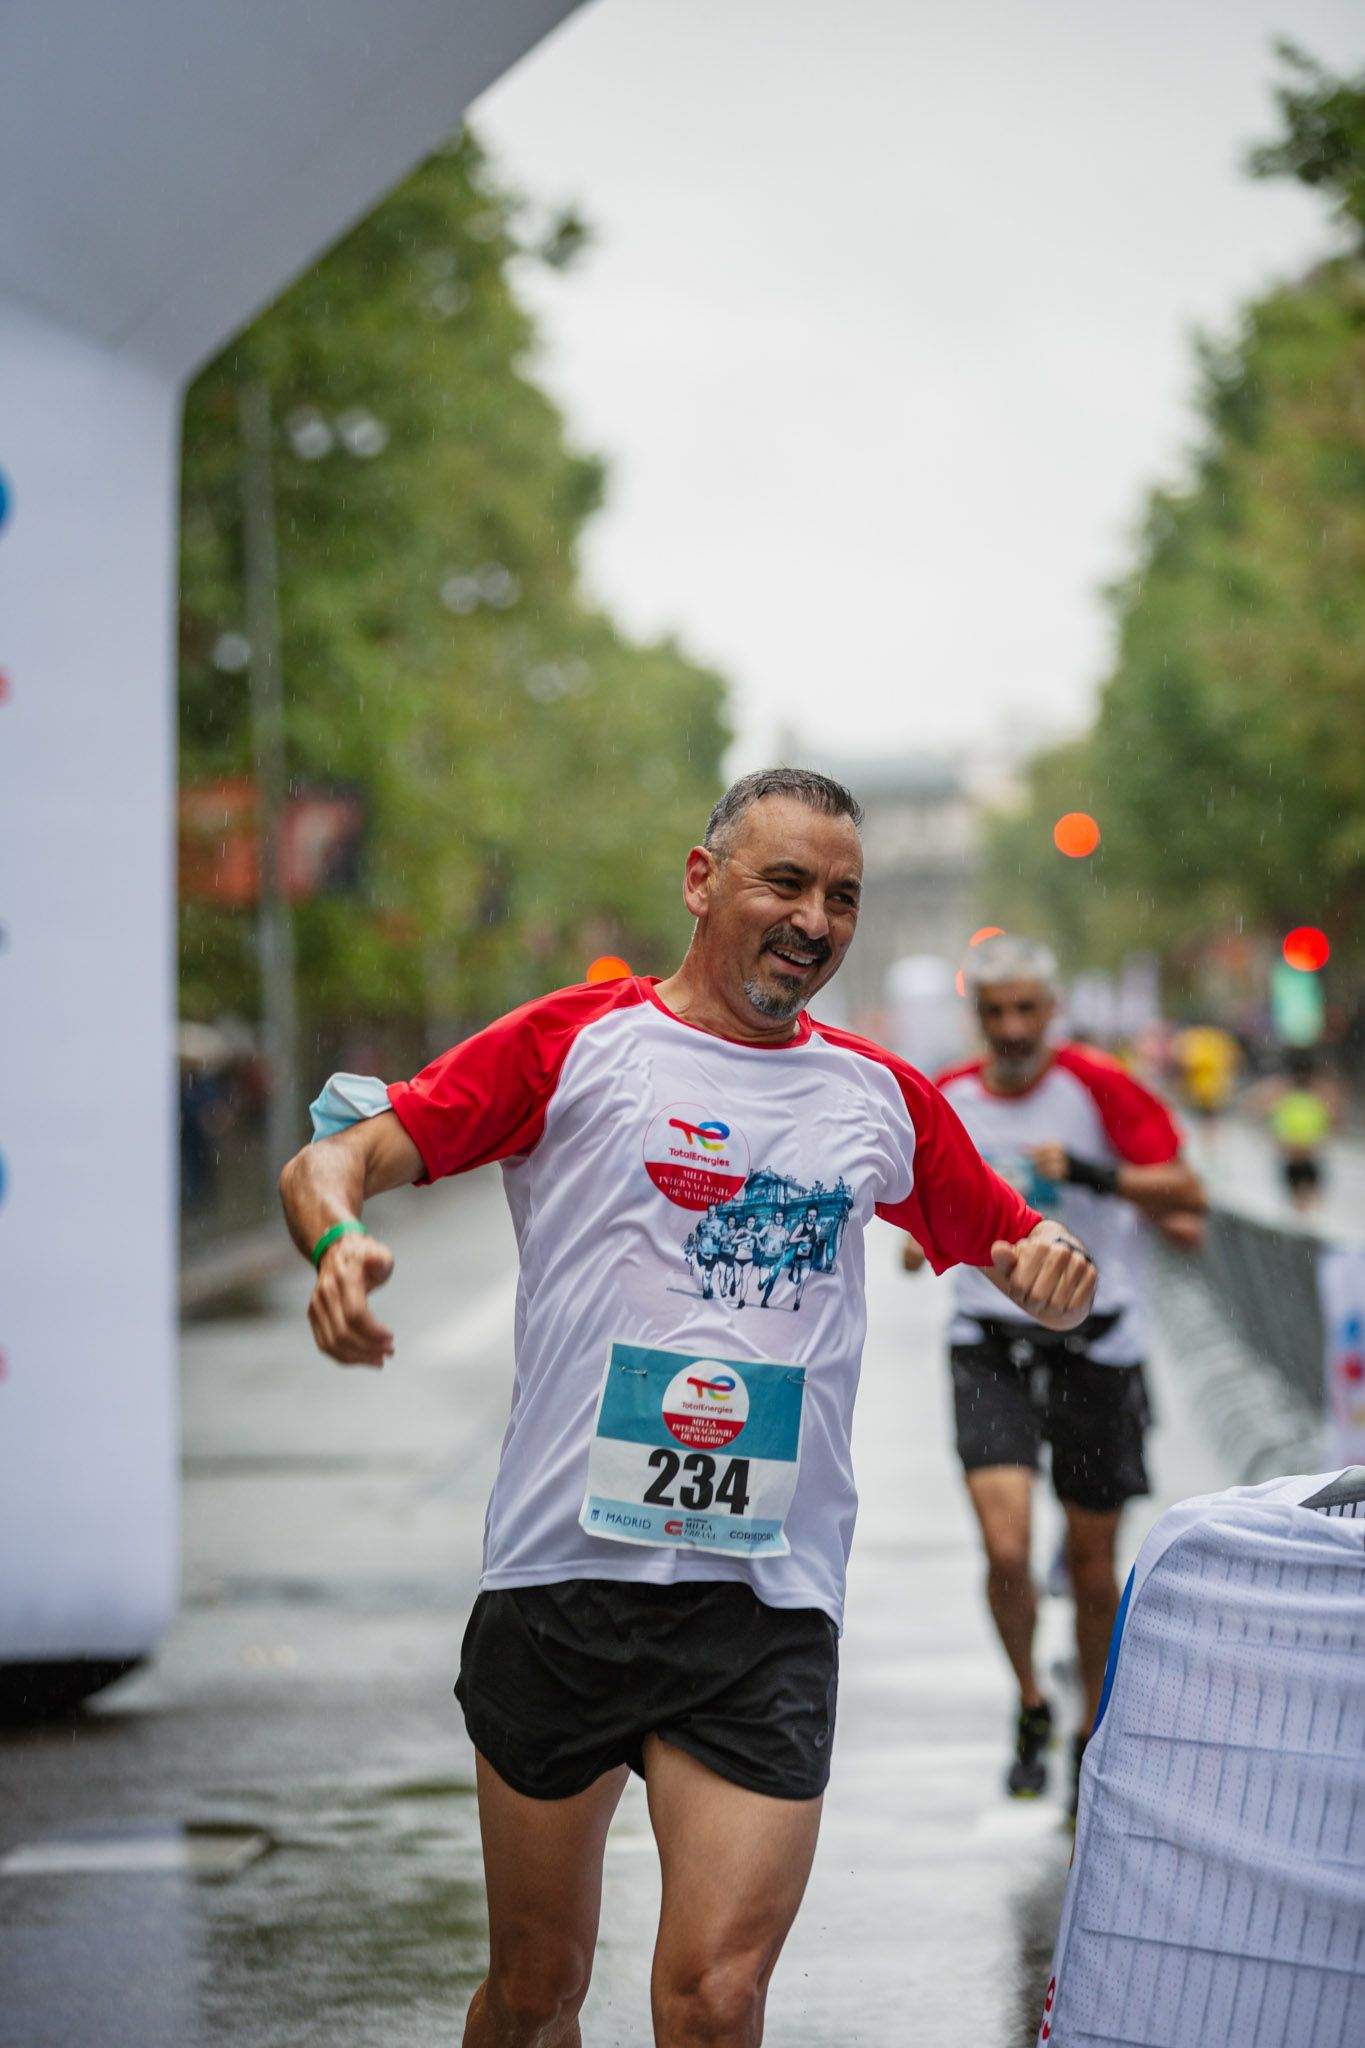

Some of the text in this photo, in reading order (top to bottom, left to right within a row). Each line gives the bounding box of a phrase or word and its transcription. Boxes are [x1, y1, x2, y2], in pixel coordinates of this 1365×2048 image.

[669, 1147, 730, 1166] TotalEnergies
[683, 1170, 711, 1183] MILLA
[669, 1188, 719, 1204] DE MADRID
[682, 1402, 733, 1414] TotalEnergies
[692, 1418, 716, 1428] MILLA
[680, 1433, 724, 1444] DE MADRID
[643, 1448, 750, 1515] 234
[606, 1513, 651, 1530] MADRID
[685, 1522, 712, 1531] MILLA
